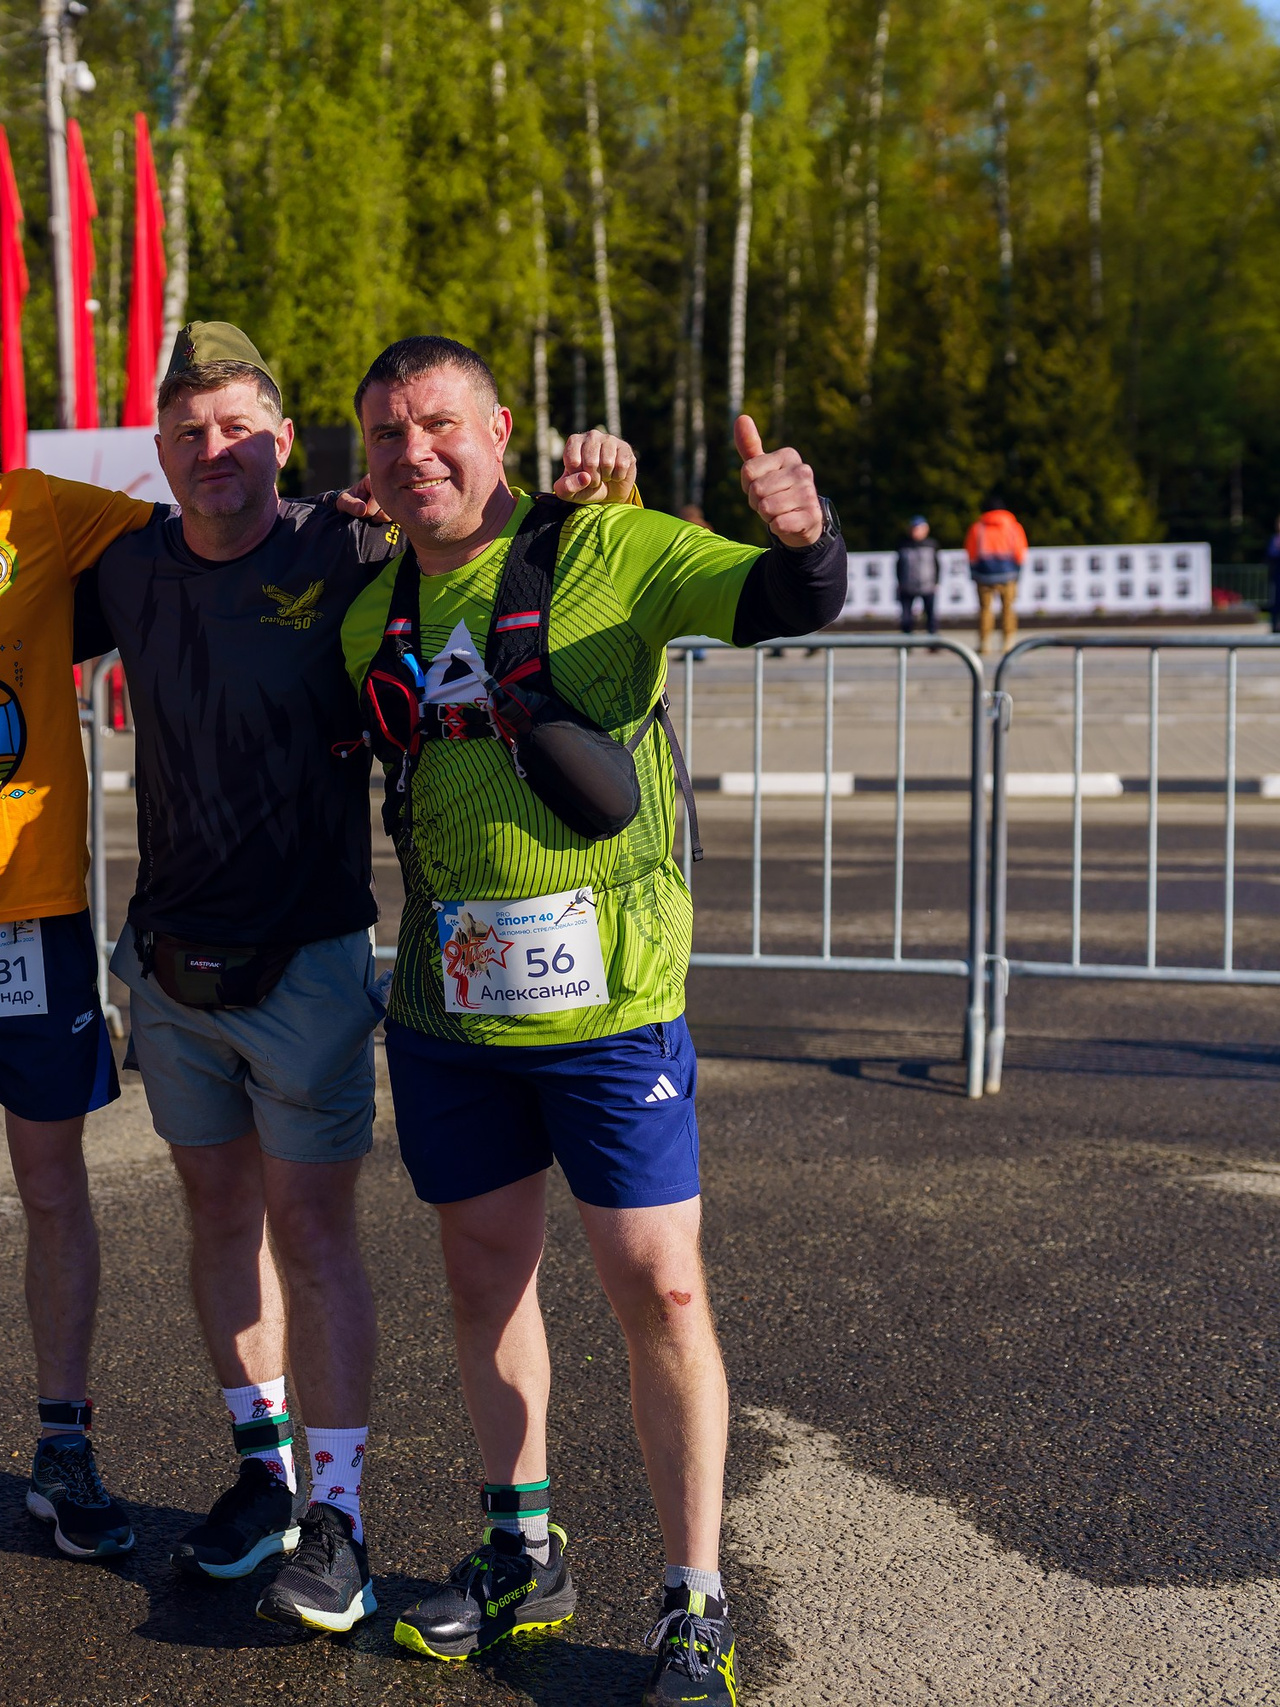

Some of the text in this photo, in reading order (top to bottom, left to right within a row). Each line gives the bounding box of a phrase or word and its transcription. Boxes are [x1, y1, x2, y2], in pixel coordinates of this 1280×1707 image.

[294, 617, 311, 630] 50
[497, 916, 536, 926] СПОРТ
[538, 912, 554, 922] 40
[526, 943, 575, 978] 56
[480, 979, 590, 1000] Александр
[74, 1010, 94, 1025] NIKE
[498, 1578, 538, 1608] GORE-TEX
